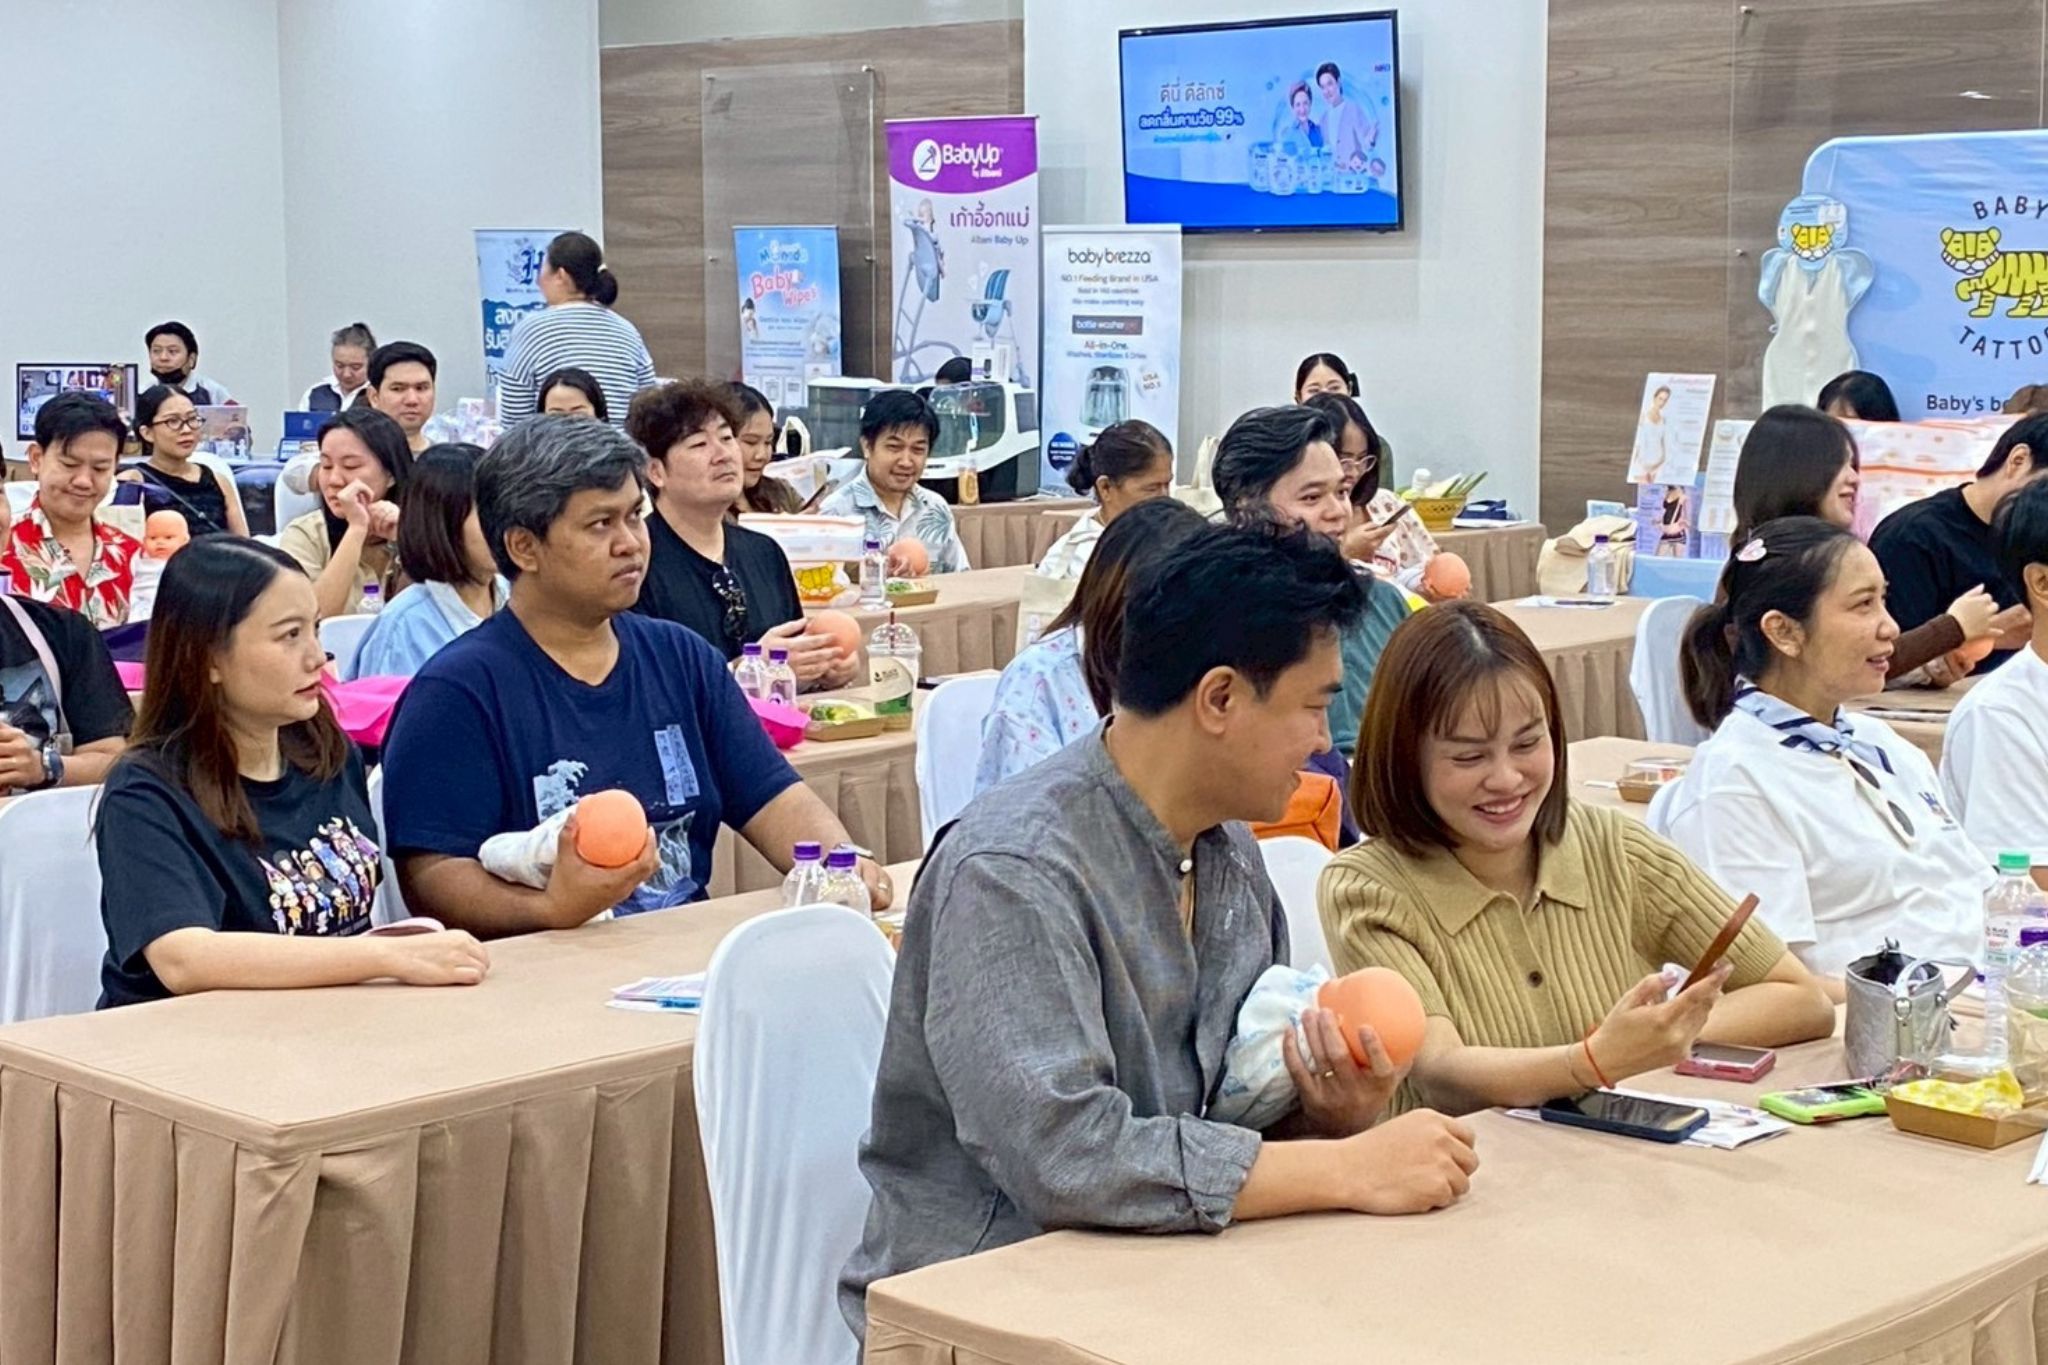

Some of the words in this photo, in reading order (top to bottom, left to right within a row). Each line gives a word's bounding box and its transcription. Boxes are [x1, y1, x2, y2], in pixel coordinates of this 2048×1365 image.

[1973, 195, 2048, 220] BABY
[751, 266, 793, 300] Baby
[1079, 273, 1108, 284] Feeding
[1959, 325, 2048, 360] TATTO
[1927, 394, 1984, 416] Baby's
